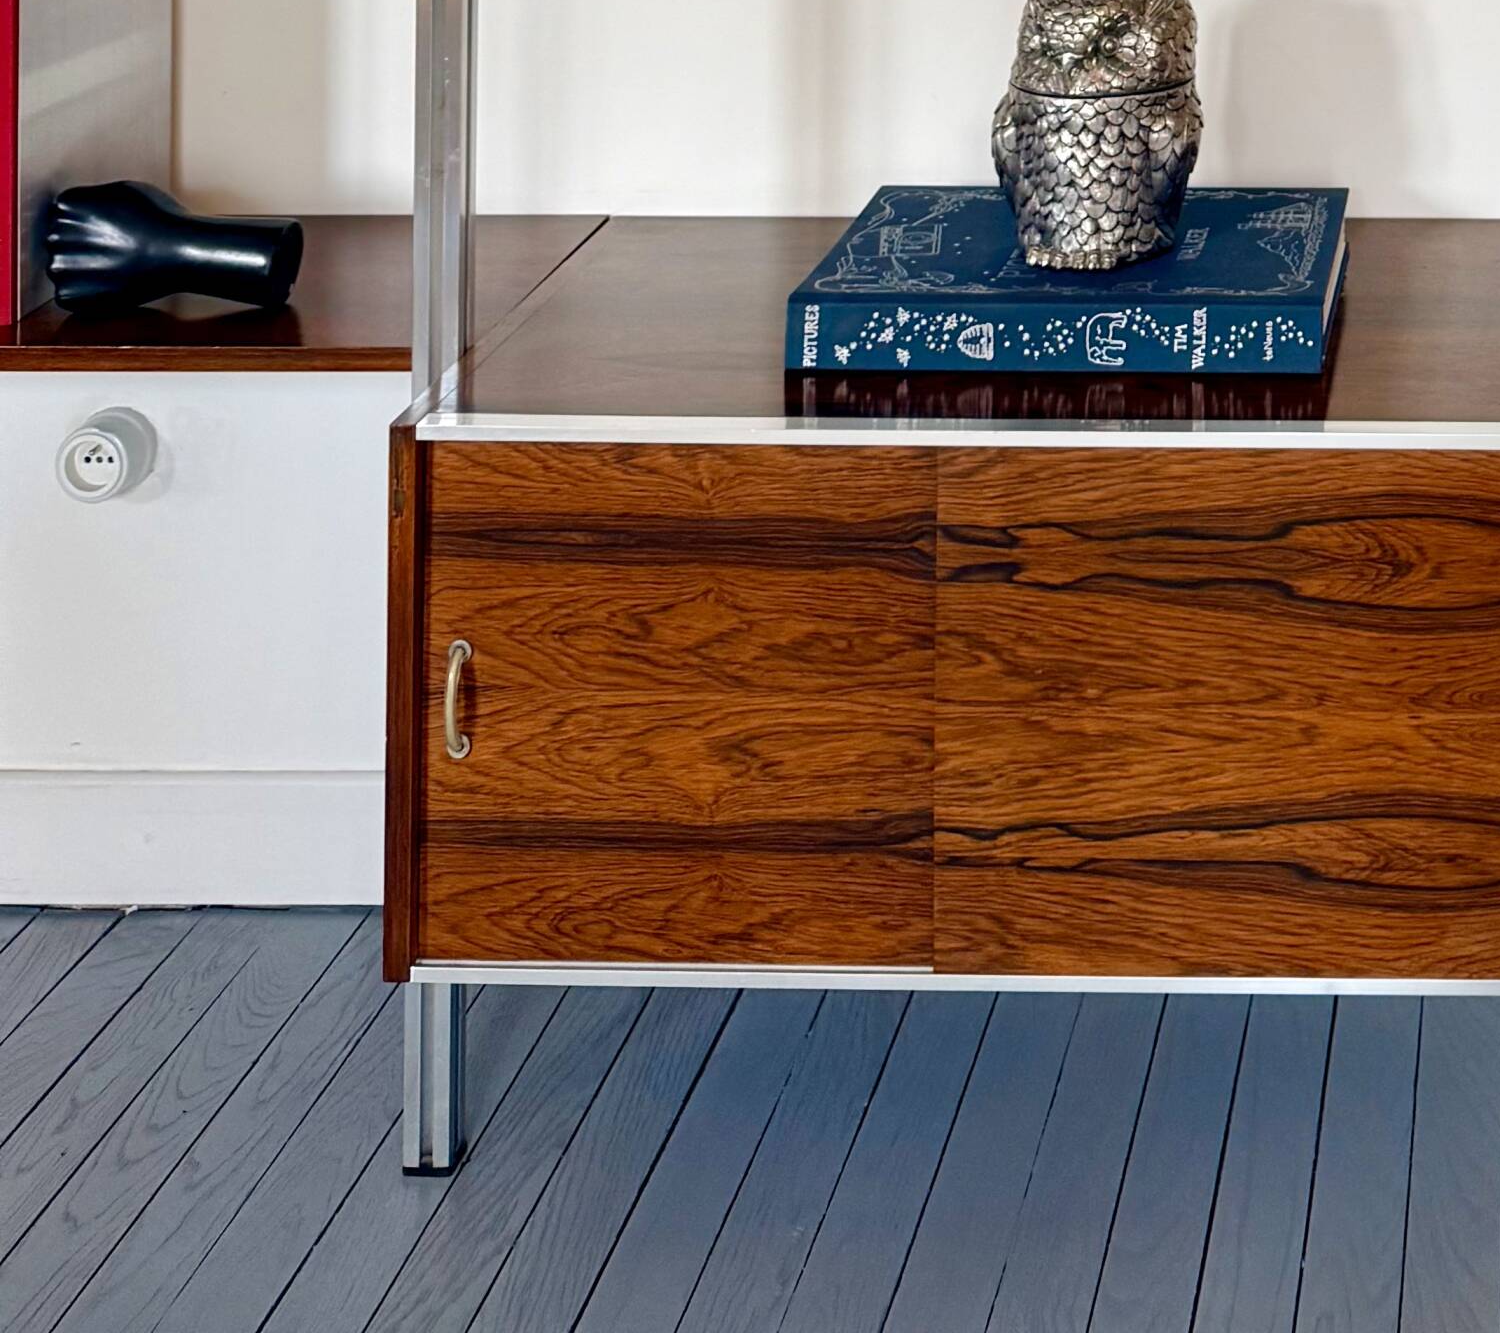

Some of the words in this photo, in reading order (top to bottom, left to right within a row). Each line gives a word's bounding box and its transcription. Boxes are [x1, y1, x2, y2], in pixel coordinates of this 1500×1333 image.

[803, 304, 820, 368] PICTURES
[1173, 323, 1188, 353] TIM
[1191, 306, 1207, 370] WALKER
